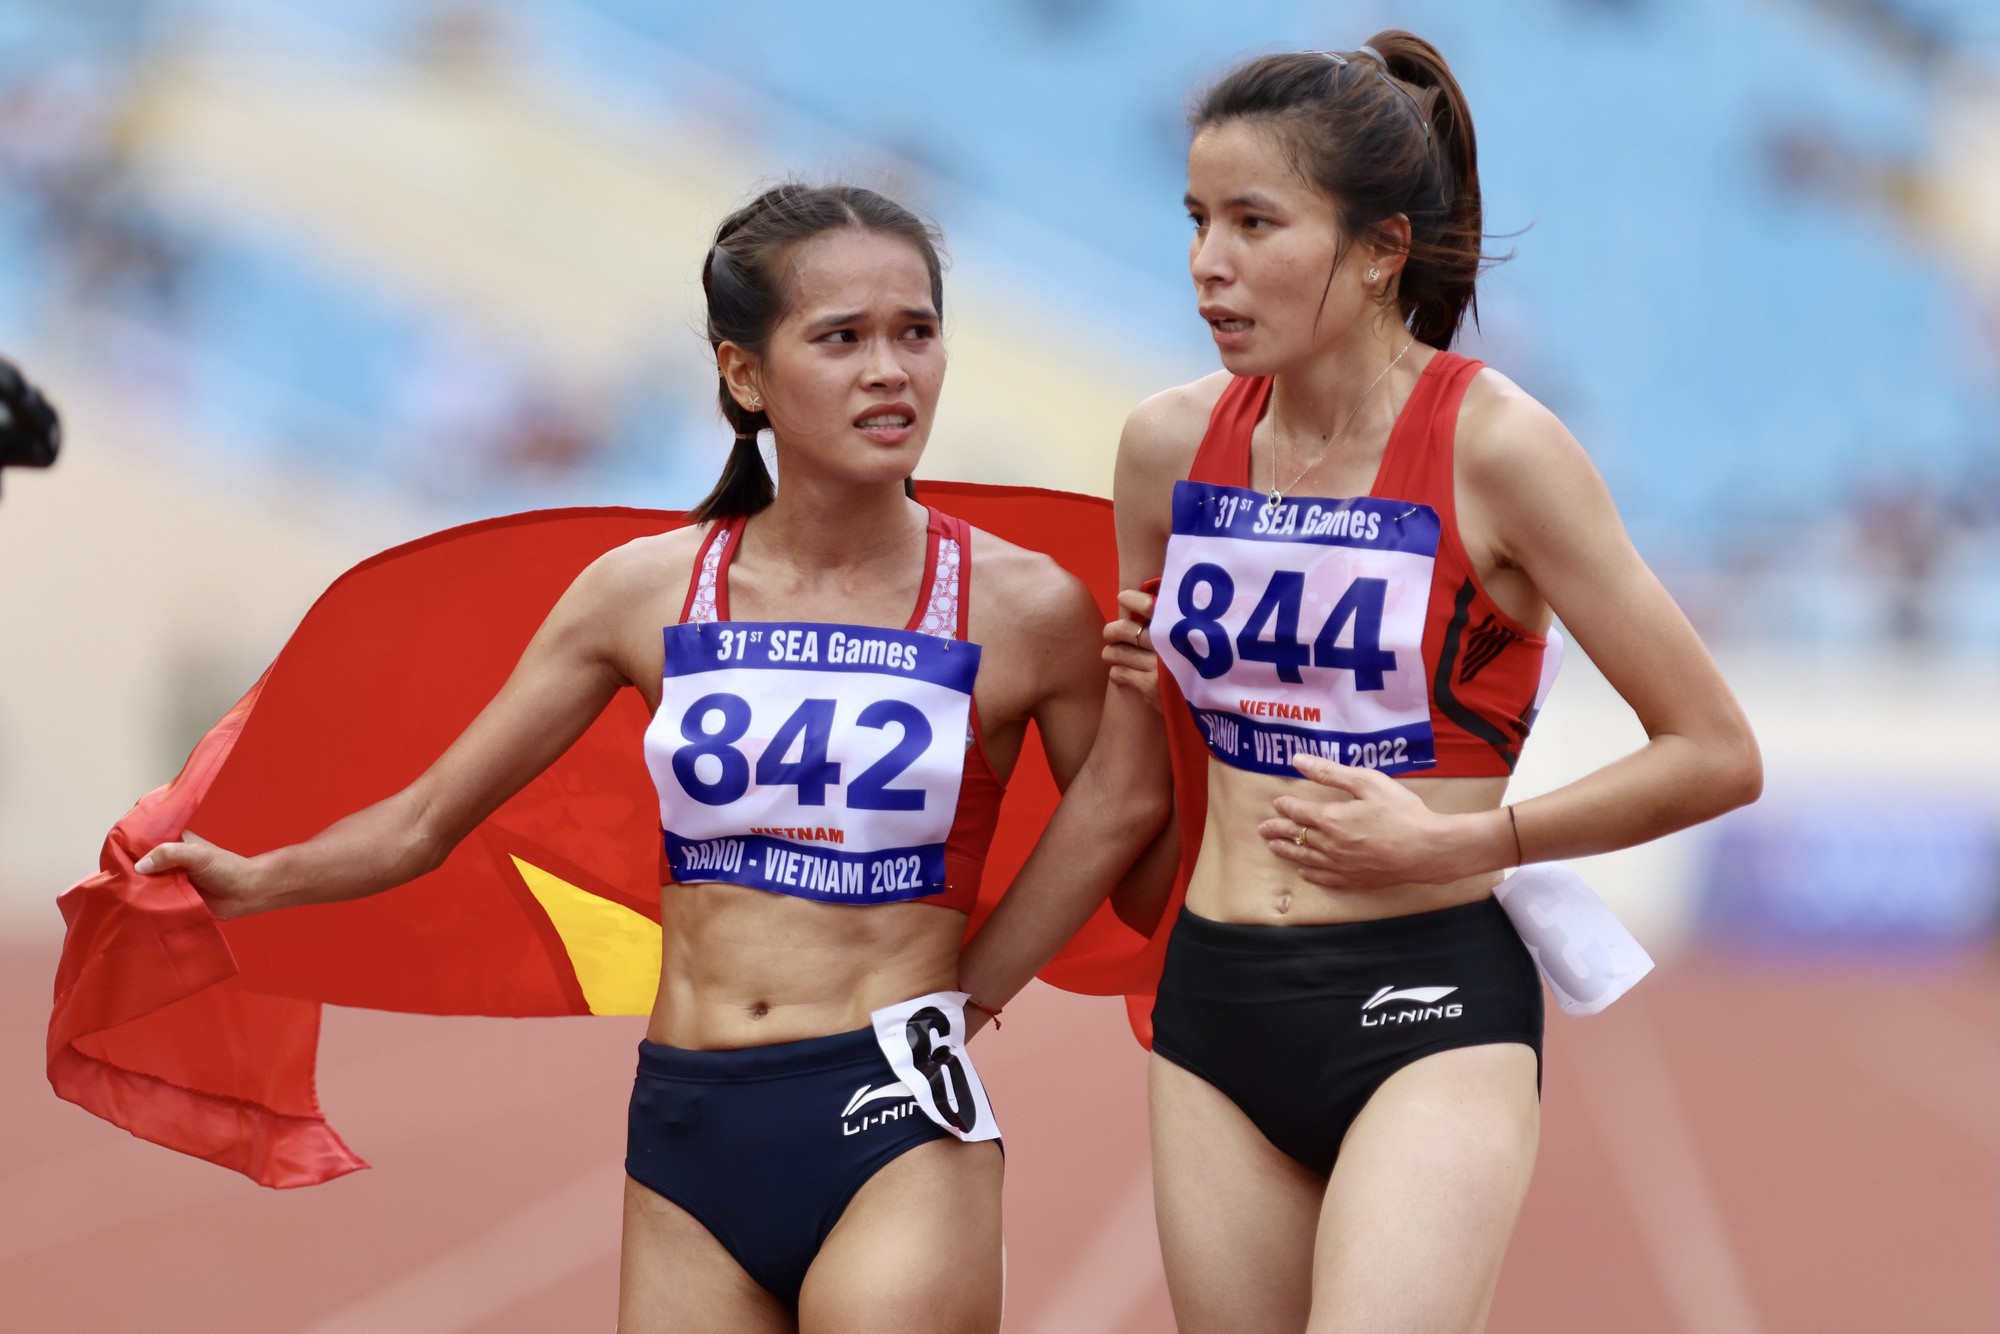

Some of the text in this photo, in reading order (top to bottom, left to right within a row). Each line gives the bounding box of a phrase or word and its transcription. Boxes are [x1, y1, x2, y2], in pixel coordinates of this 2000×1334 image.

[1253, 504, 1299, 536] SEA
[1301, 505, 1381, 541] Games
[1169, 562, 1397, 692] 844
[768, 630, 818, 662] SEA
[827, 631, 918, 670] Games
[1240, 700, 1321, 722] VIETNAM
[672, 692, 933, 811] 842
[1348, 737, 1408, 769] 2022
[681, 840, 745, 873] HANOI
[764, 847, 864, 894] VIETNAM
[871, 855, 923, 894] 2022
[1362, 1004, 1463, 1027] LI-NING
[906, 1006, 977, 1134] 6
